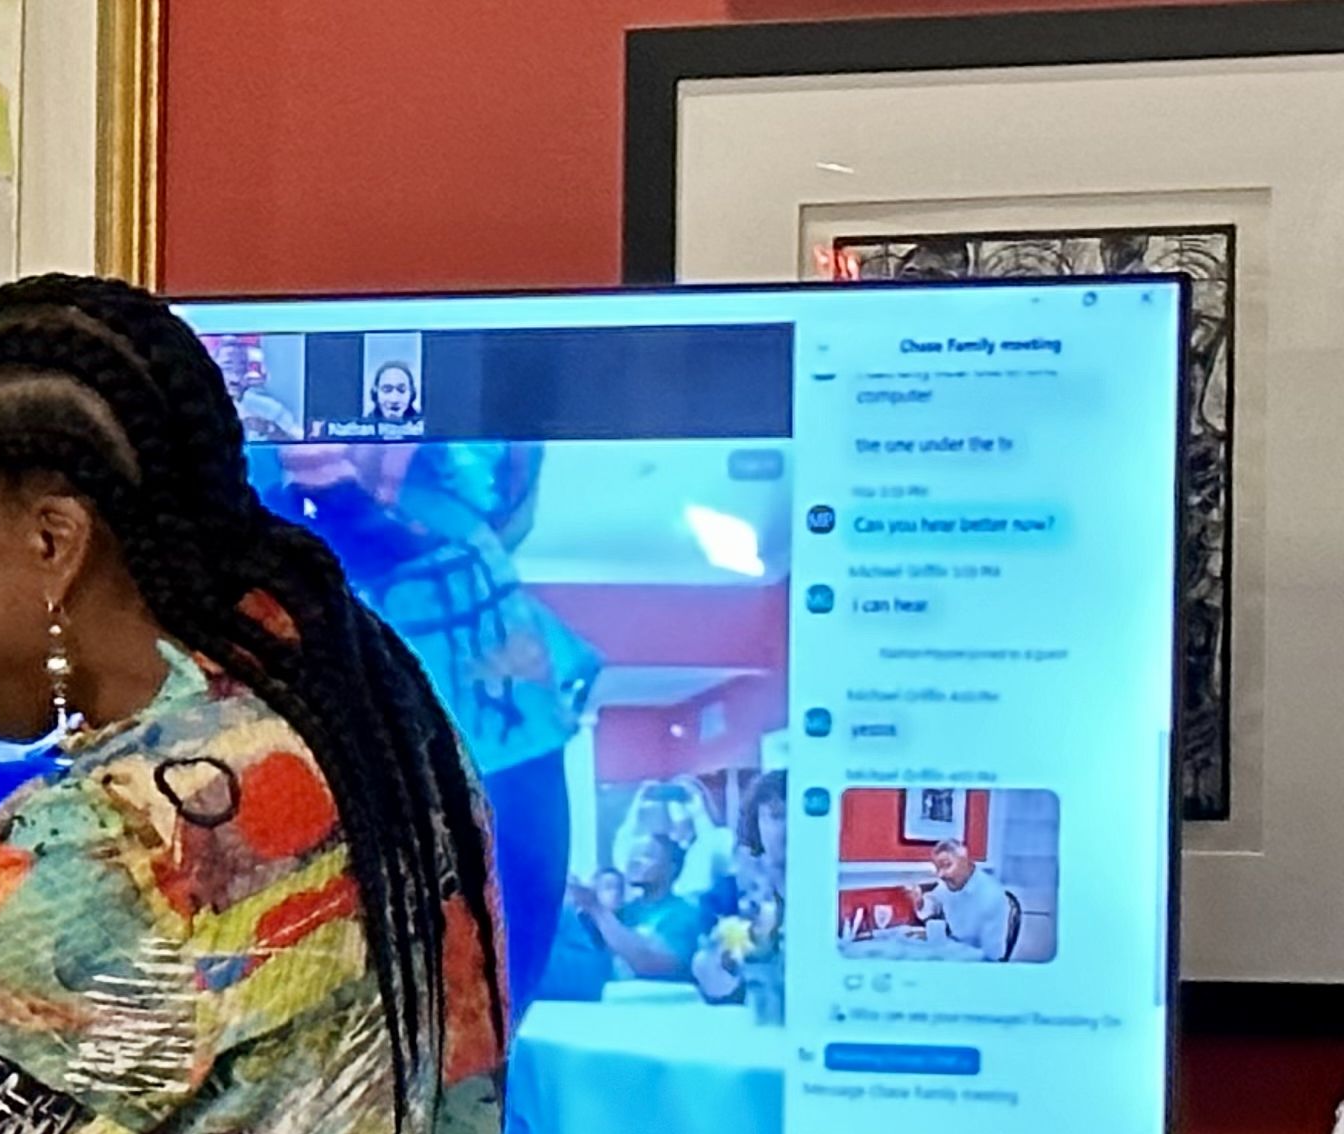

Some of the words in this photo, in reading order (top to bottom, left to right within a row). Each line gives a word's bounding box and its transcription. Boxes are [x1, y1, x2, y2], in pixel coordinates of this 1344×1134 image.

[947, 338, 996, 356] Family
[918, 437, 965, 453] under
[968, 437, 995, 453] the
[854, 517, 885, 534] Can
[888, 519, 917, 536] you
[920, 516, 956, 534] hear
[959, 516, 1008, 534] better
[1012, 516, 1055, 533] now?
[862, 602, 890, 614] can
[893, 600, 928, 614] hear
